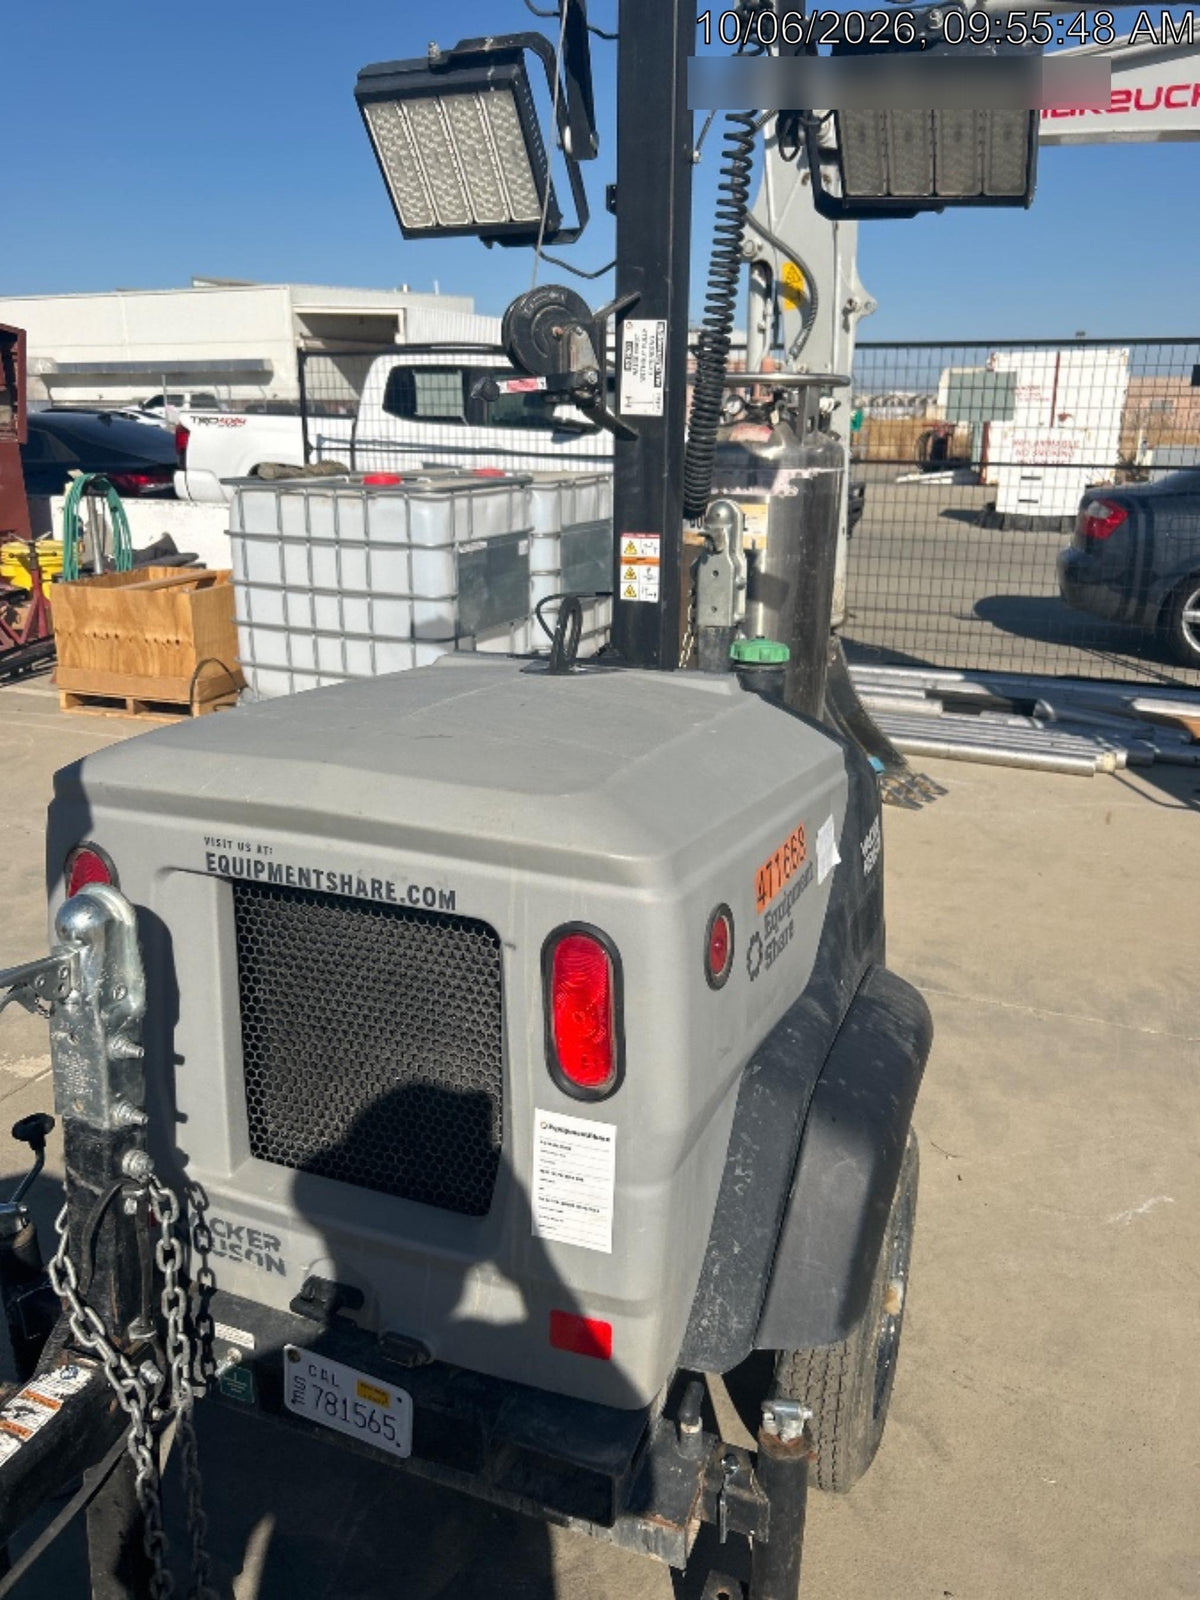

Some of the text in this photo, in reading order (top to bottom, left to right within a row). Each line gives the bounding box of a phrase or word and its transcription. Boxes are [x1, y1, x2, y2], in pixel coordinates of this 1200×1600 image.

[203, 836, 273, 856] VISIT US AT:
[205, 850, 457, 912] EQUIPMENTSHARE.COM
[190, 1212, 281, 1253] CKER
[308, 1364, 340, 1388] CAL
[312, 1383, 397, 1442] 781565
